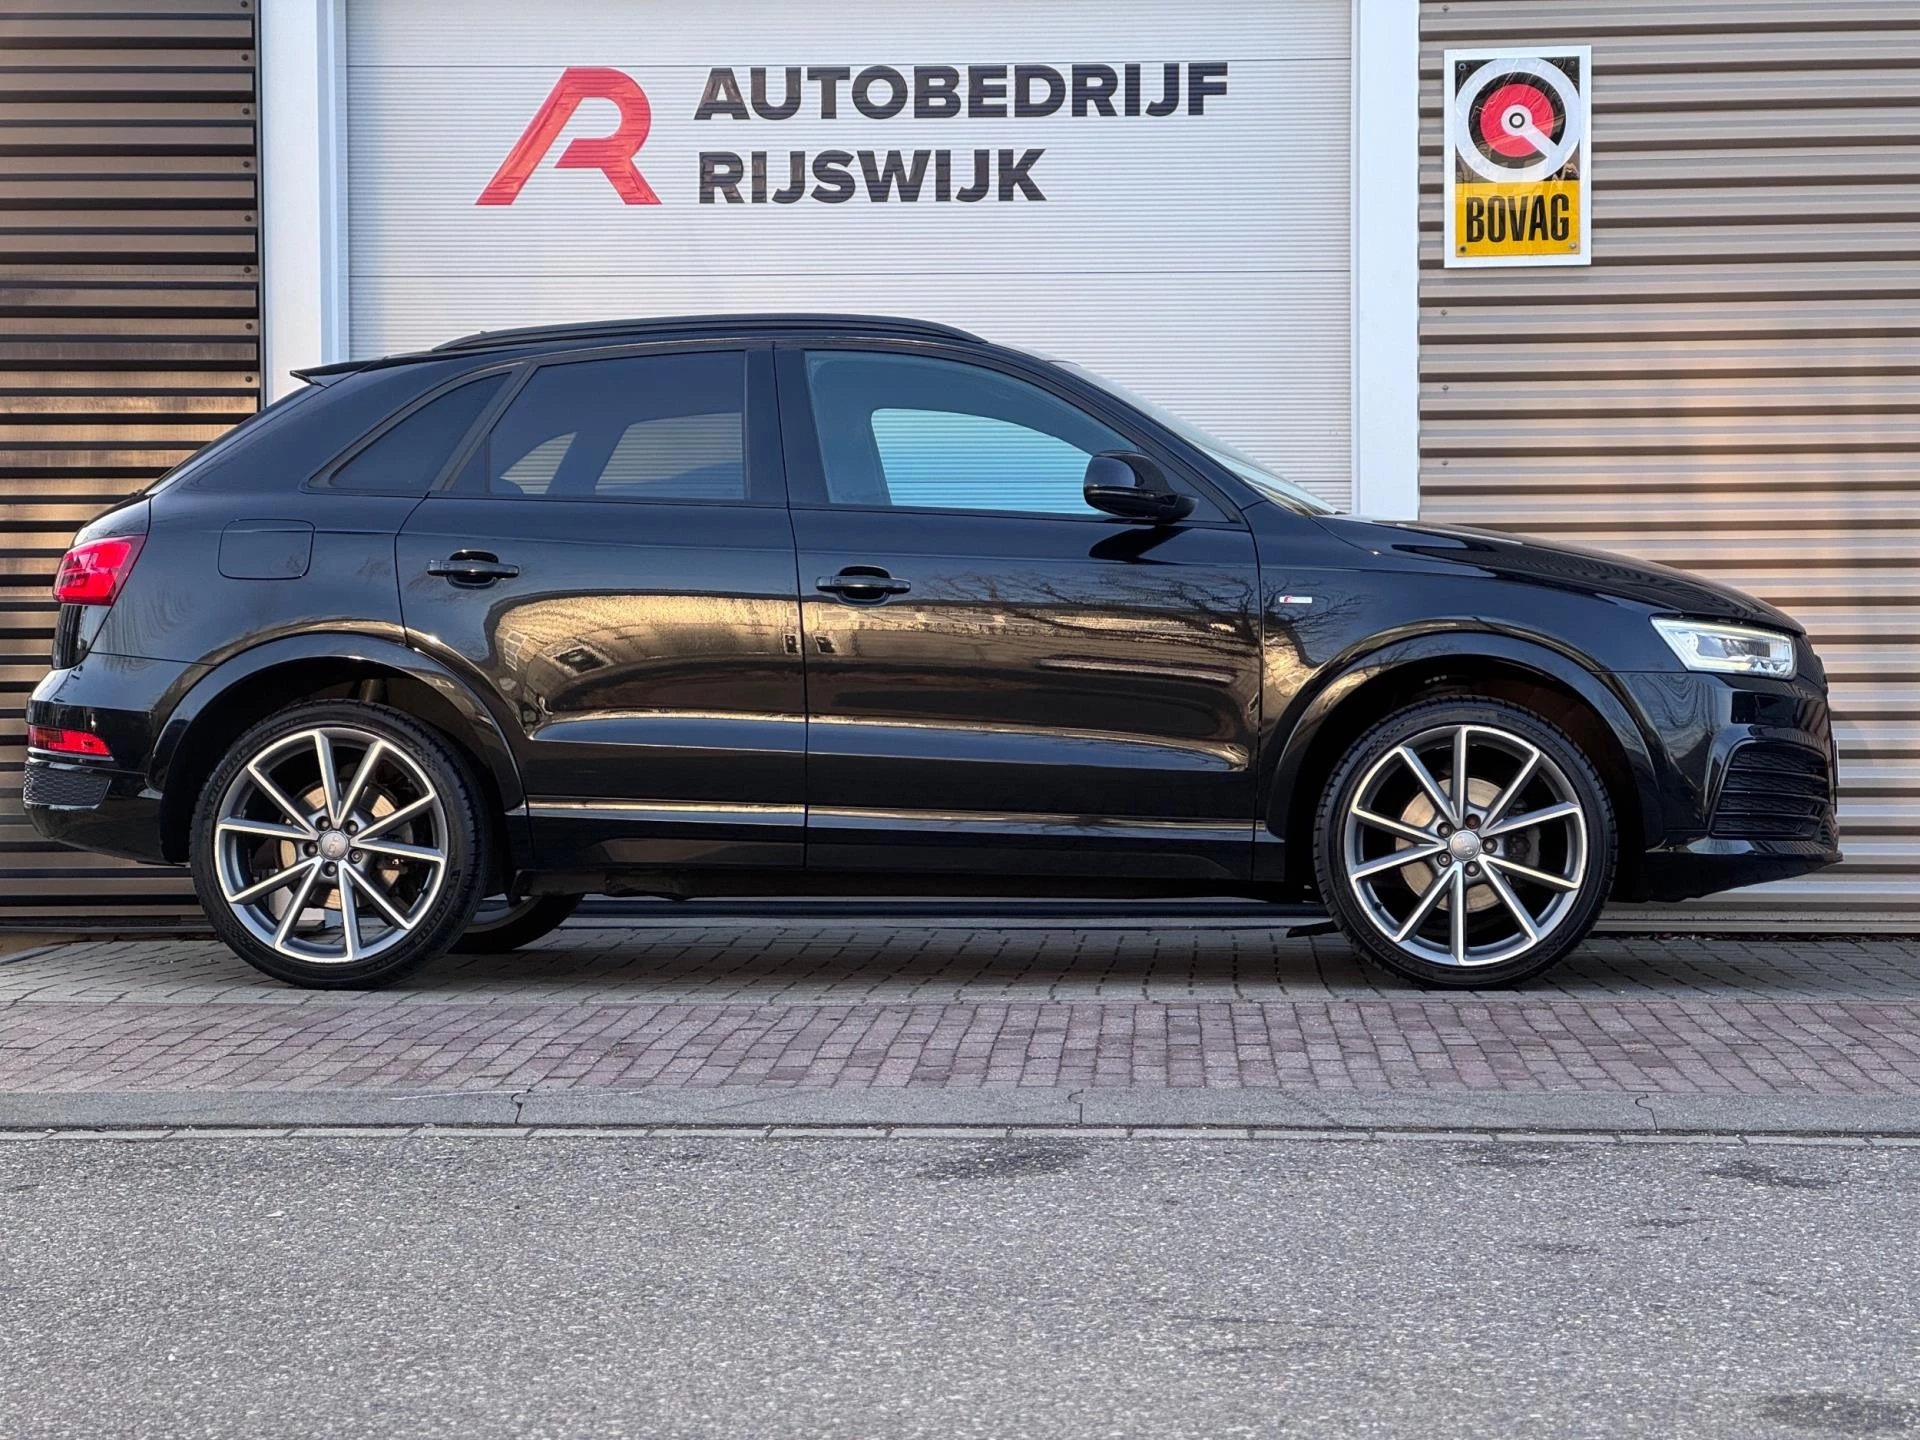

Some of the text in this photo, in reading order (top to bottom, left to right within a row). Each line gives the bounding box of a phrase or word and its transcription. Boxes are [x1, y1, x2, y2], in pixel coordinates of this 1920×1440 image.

[694, 62, 1228, 120] AUTOBEDRIJF
[699, 148, 1047, 204] RIJSWIJK
[1466, 193, 1570, 243] BOVAG
[411, 887, 455, 945] MICHELIN
